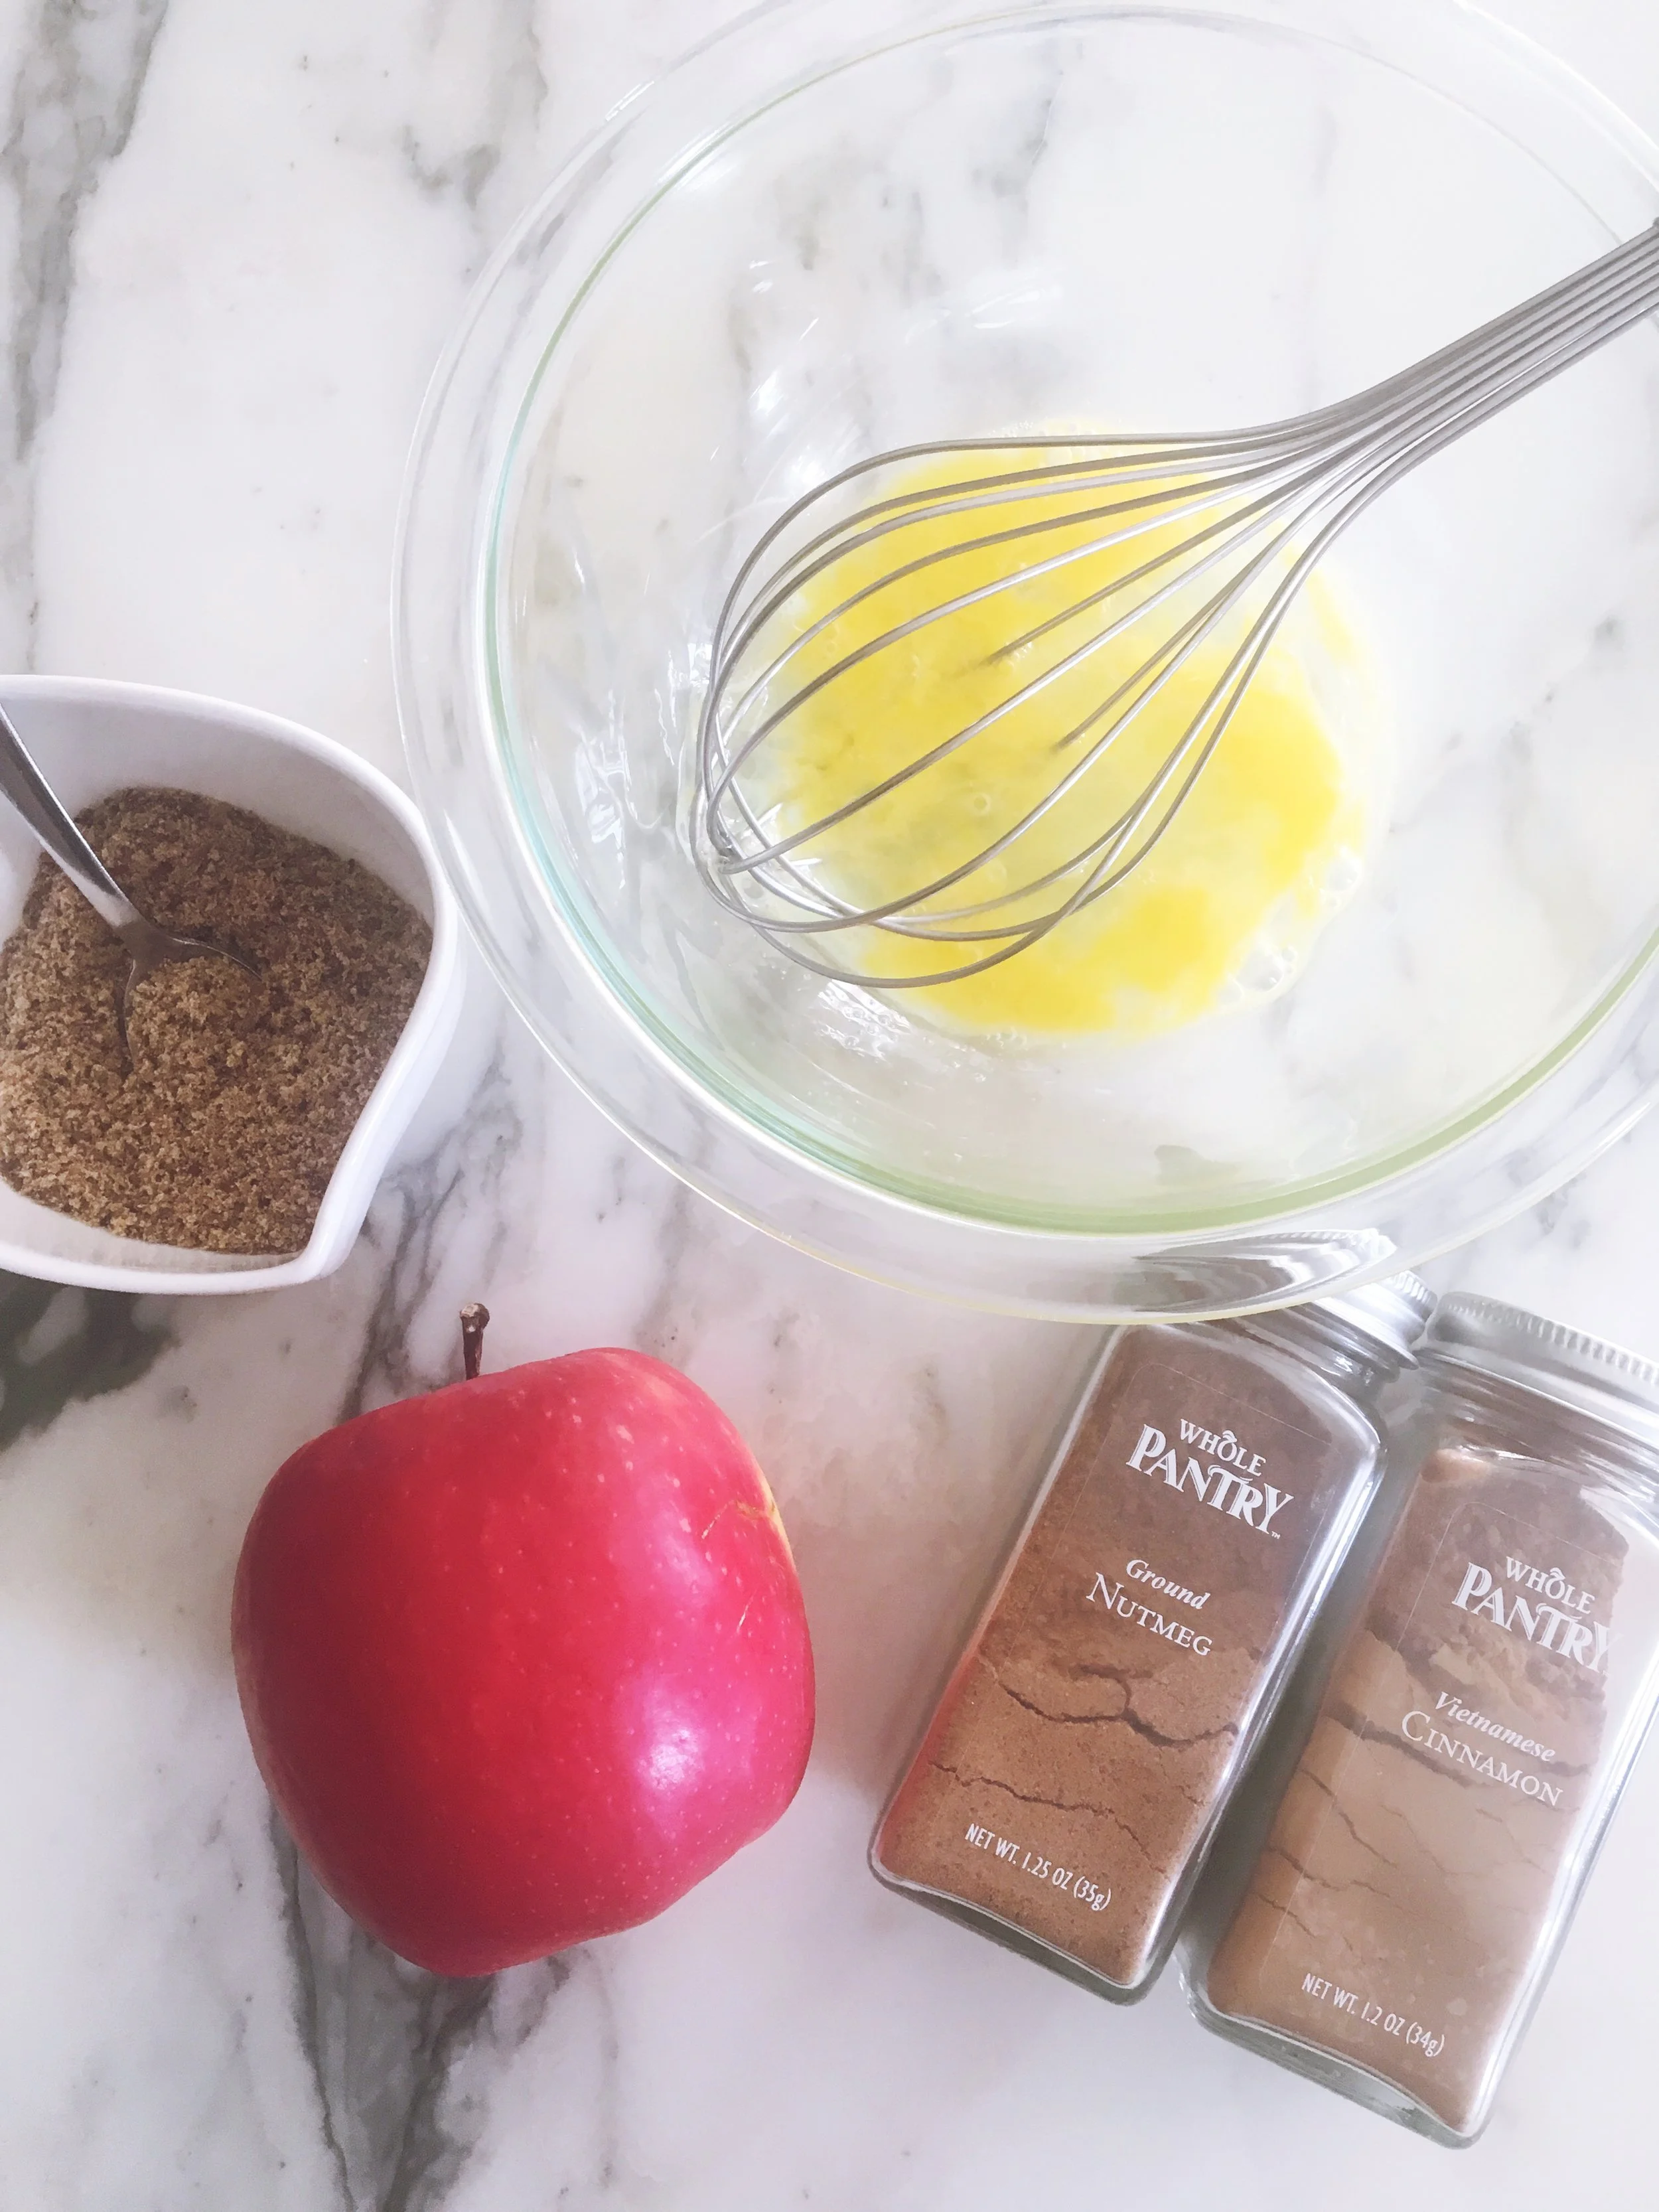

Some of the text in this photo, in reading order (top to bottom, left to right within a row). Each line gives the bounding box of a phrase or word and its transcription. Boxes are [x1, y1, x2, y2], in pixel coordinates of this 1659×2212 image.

[1125, 1424, 1295, 1534] PANTRY
[1179, 1418, 1266, 1477] WHOLE
[1086, 1572, 1213, 1657] NUTMEG
[1126, 1559, 1211, 1610] Ground
[1451, 1562, 1624, 1672] PANTRY
[1505, 1556, 1595, 1615] WHOLE
[1402, 1710, 1563, 1806] CINNAMON
[1435, 1691, 1555, 1762] Vietnamese
[965, 1823, 1112, 1911] NET WT. 1.25 OZ (35g)
[1301, 1972, 1445, 2058] NET WT. 1.2 OZ (34g)
